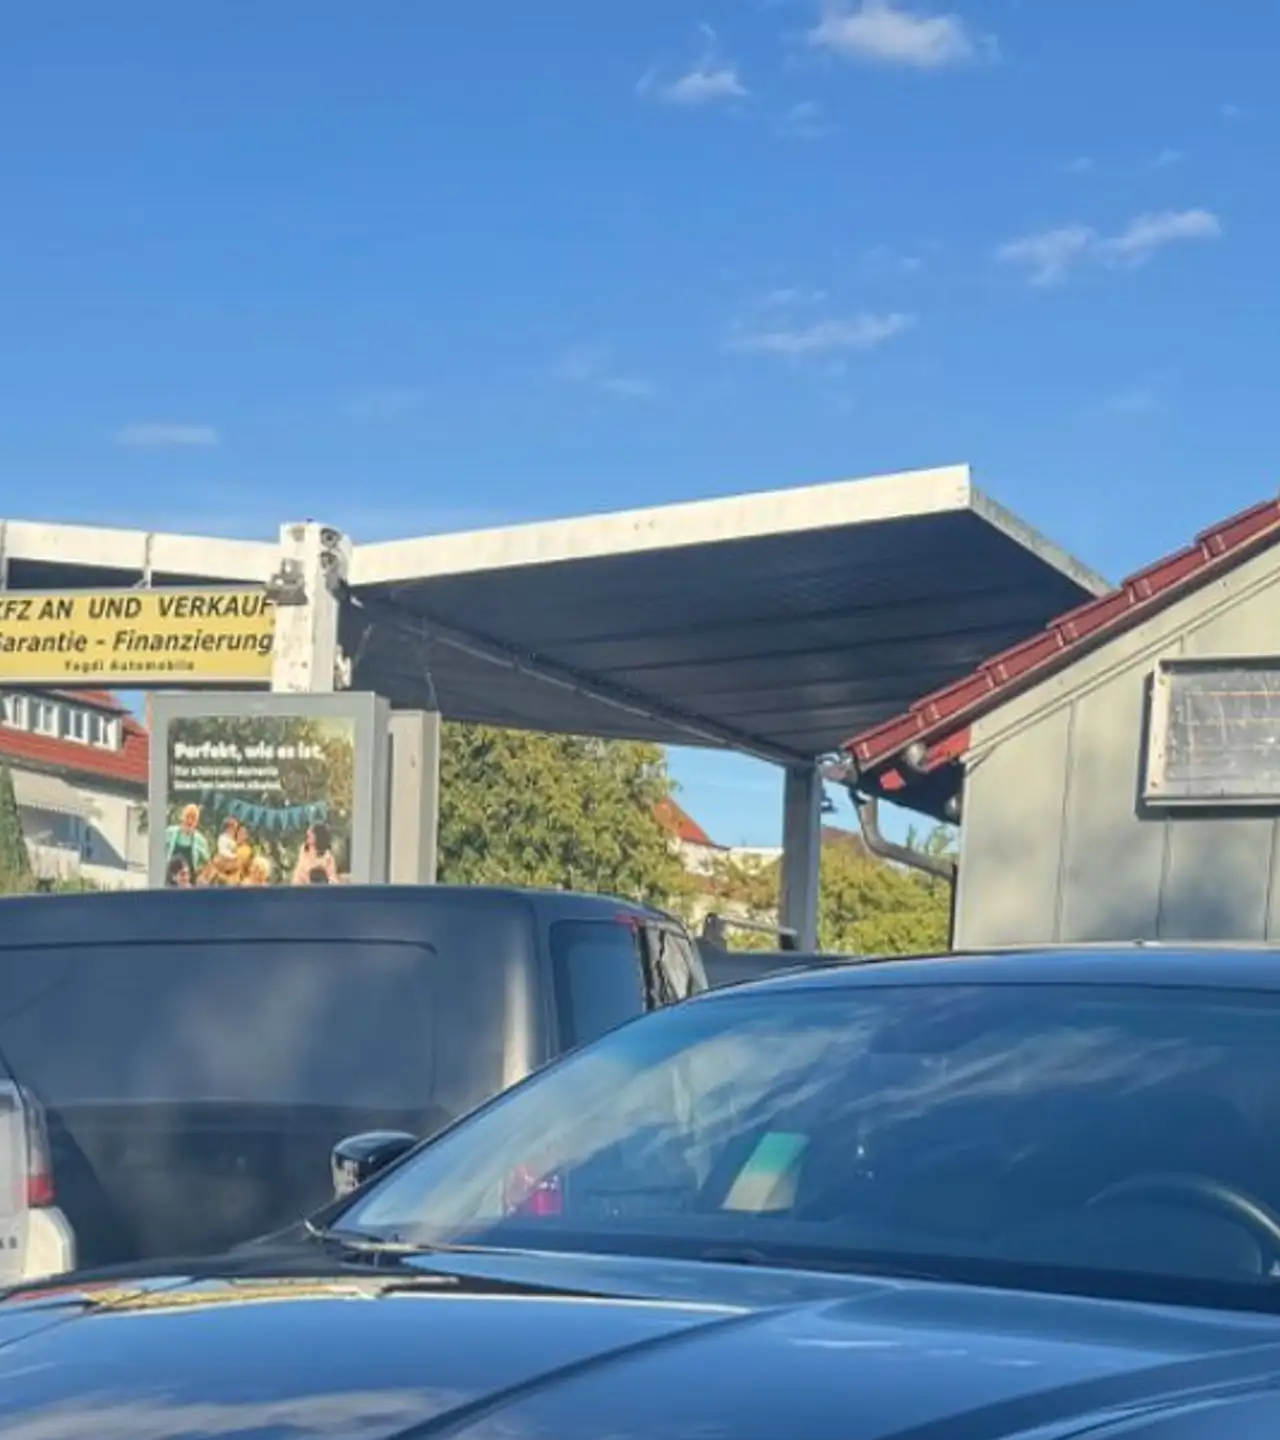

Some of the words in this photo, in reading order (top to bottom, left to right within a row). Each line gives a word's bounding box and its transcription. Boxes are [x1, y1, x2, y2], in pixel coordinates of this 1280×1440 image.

[38, 599, 74, 621] AN
[88, 597, 141, 619] UND
[158, 595, 274, 618] VERKAUF
[112, 628, 274, 657] Finanzierung
